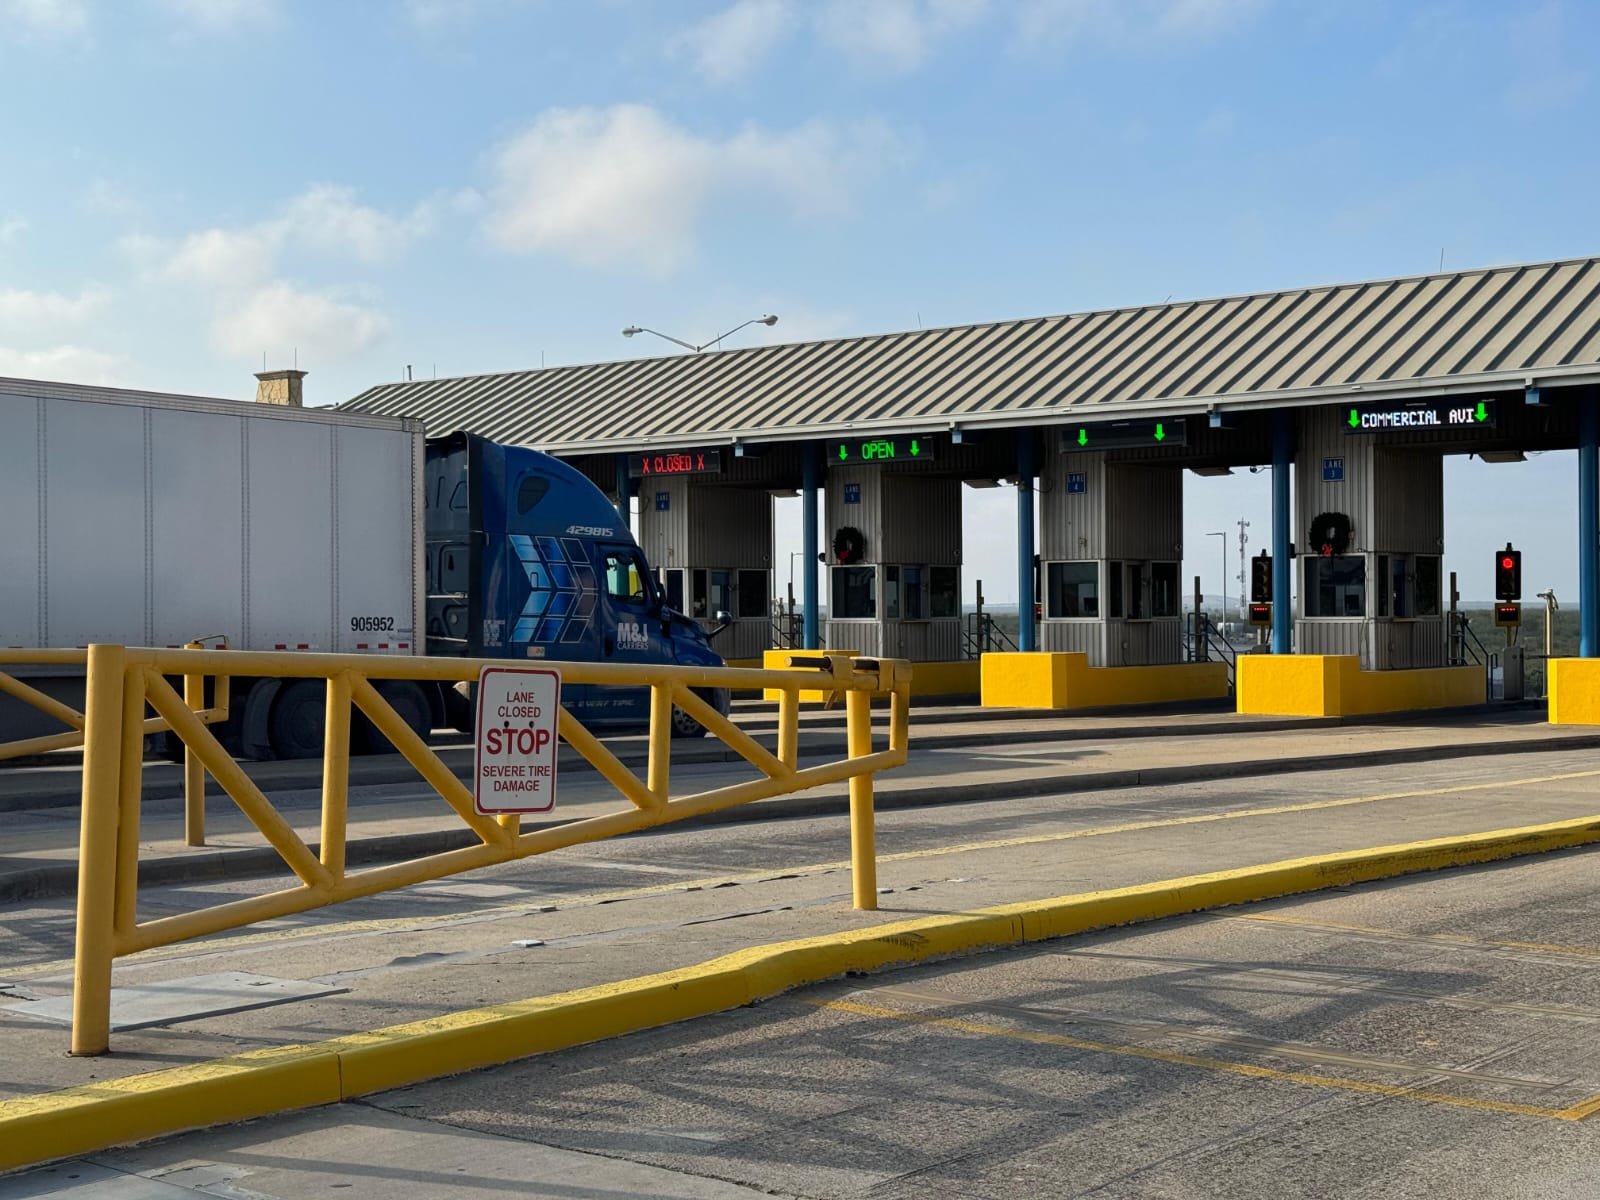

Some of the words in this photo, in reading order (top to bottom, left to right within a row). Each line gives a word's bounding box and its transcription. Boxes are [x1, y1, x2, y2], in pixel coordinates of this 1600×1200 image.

[1361, 410, 1441, 428] COMMERCIAL
[1449, 408, 1475, 424] AVI
[861, 442, 895, 460] OPEN
[654, 455, 692, 473] CLOSED
[1323, 459, 1343, 469] LANE
[566, 525, 614, 537] 429815
[351, 616, 394, 632] 905952
[617, 622, 649, 642] M&J
[506, 691, 535, 703] LANE
[498, 706, 541, 718] CLOSED
[486, 728, 550, 755] STOP
[482, 765, 525, 777] SEVERE
[528, 765, 550, 777] TIRE
[493, 780, 540, 792] DAMAGE
